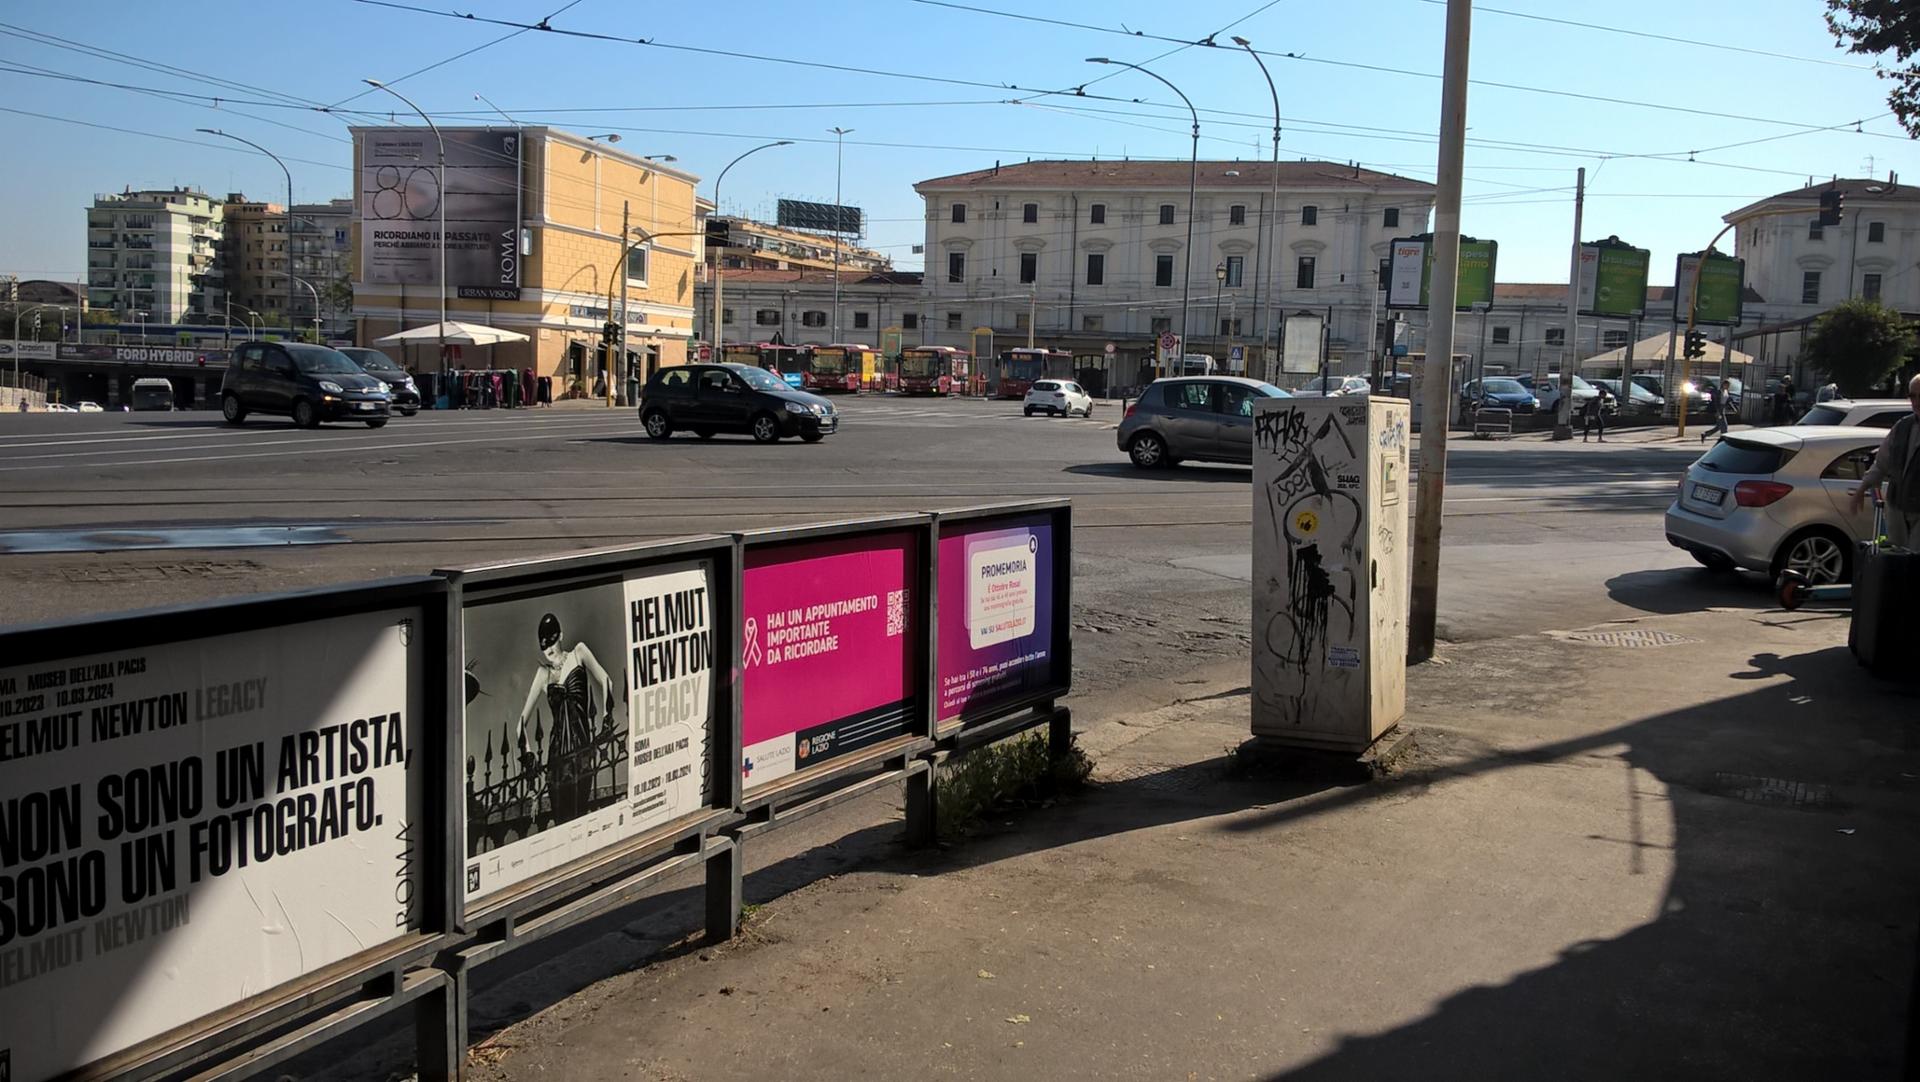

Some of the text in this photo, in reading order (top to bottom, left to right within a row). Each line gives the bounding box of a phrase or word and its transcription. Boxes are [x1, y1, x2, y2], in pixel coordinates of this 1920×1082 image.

[374, 230, 491, 241] RICORDIAMO IL PASSATO
[501, 229, 515, 284] ROMA
[1397, 247, 1420, 257] tigre
[460, 288, 517, 298] URBAN VISION
[116, 348, 195, 362] FORD HYBRID
[982, 560, 1027, 579] PROMEMORIA
[631, 587, 706, 643] HELMUT
[767, 595, 878, 630] HAI UN APPUNTAMENTO
[767, 621, 830, 648] IMPORTANTE
[633, 629, 712, 690] NEWTON
[767, 636, 839, 665] DA RICORDARE
[28, 670, 67, 691] MUSEO
[69, 662, 115, 684] DELL'ARA
[118, 657, 146, 677] PACIS
[57, 682, 114, 707] 10.03.2024
[634, 676, 701, 738] LEGACY
[91, 692, 188, 743] NEWTON
[195, 677, 267, 720] LEGACY
[634, 737, 650, 753] ROMA
[812, 731, 836, 745] REGIONE
[812, 742, 829, 754] LAZIO
[634, 751, 653, 767] MUSEO
[700, 716, 711, 796] ROMA
[756, 746, 791, 763] SALUTE LAZIO
[0, 712, 413, 868] NON SONO UN ARTISTA,
[0, 776, 383, 945] SONO UN FOTOGRAFO.
[395, 822, 414, 928] ROMA
[0, 892, 191, 988] ELMUT NEWTON
